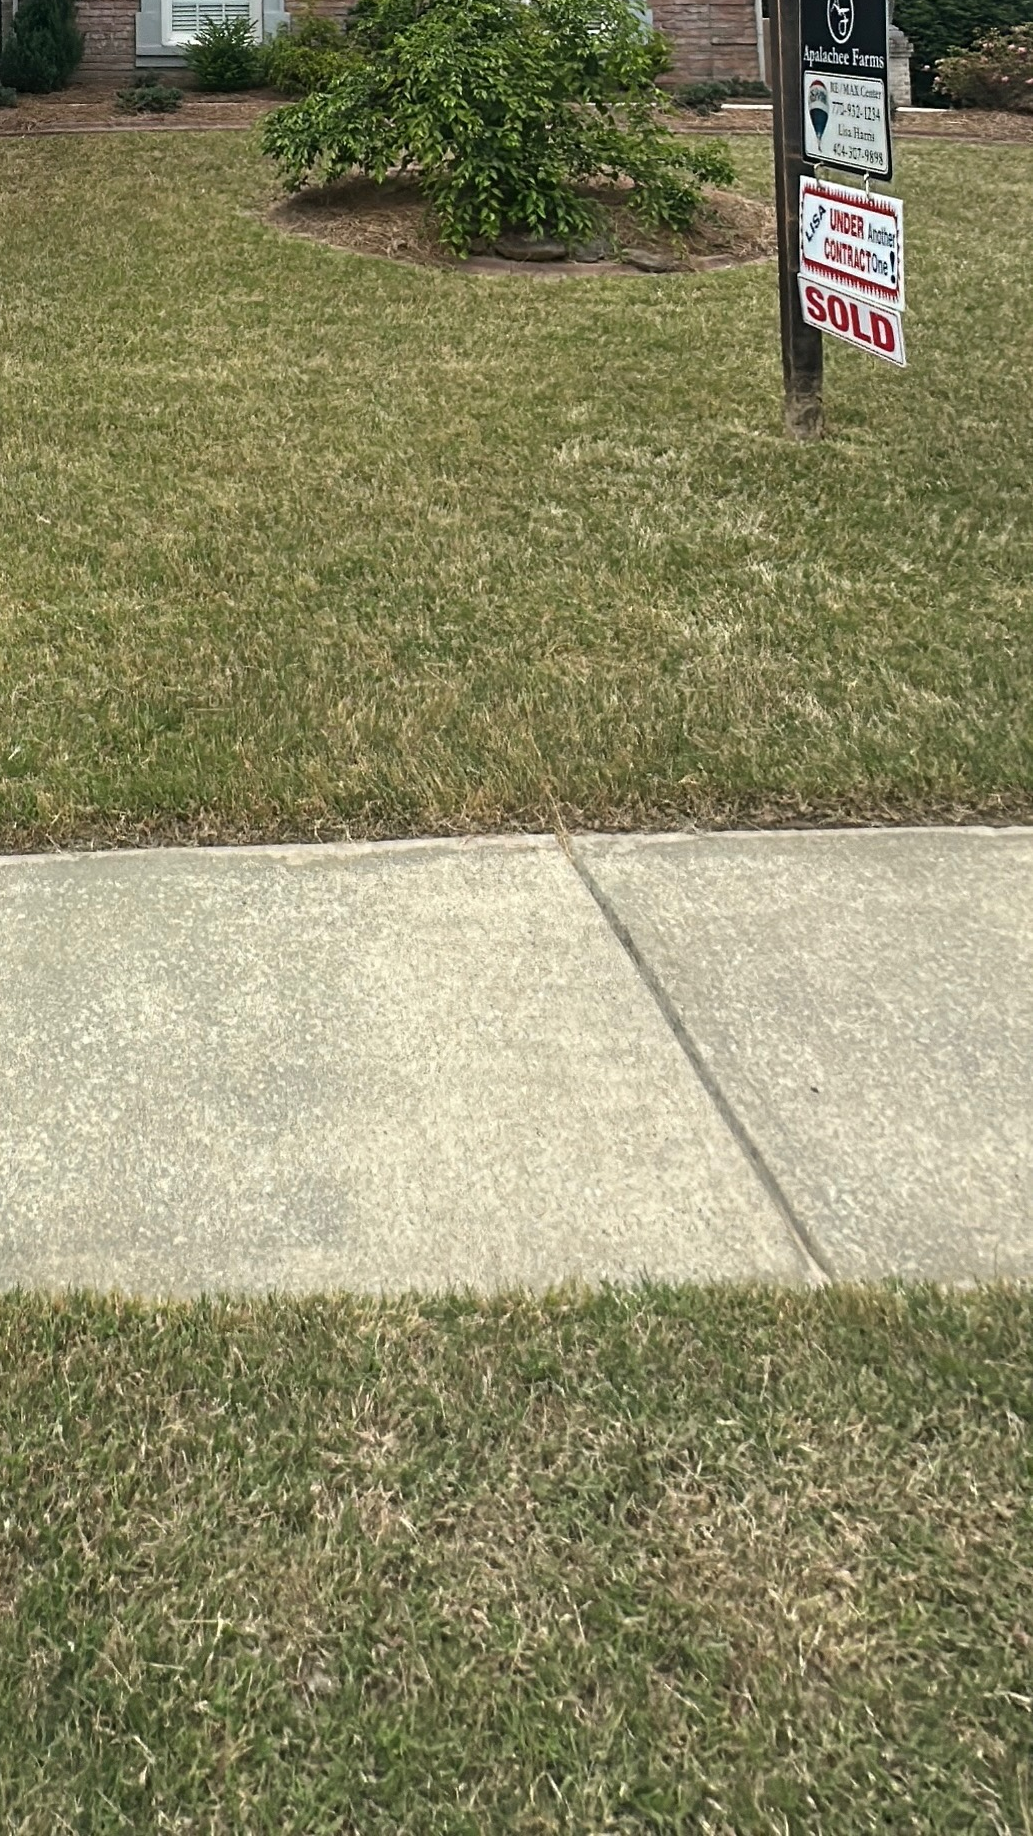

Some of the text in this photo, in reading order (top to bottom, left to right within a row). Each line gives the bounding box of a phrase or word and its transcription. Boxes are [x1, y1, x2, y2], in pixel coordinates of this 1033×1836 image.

[803, 44, 885, 69] Apalachee Farms
[860, 85, 881, 100] Center
[838, 123, 875, 142] Lisa Harris
[805, 204, 826, 242] LISA
[830, 207, 864, 240] UNDER
[868, 222, 896, 248] Another
[824, 237, 872, 274] CONTRACT
[871, 252, 888, 276] One
[805, 285, 896, 353] SOLD
